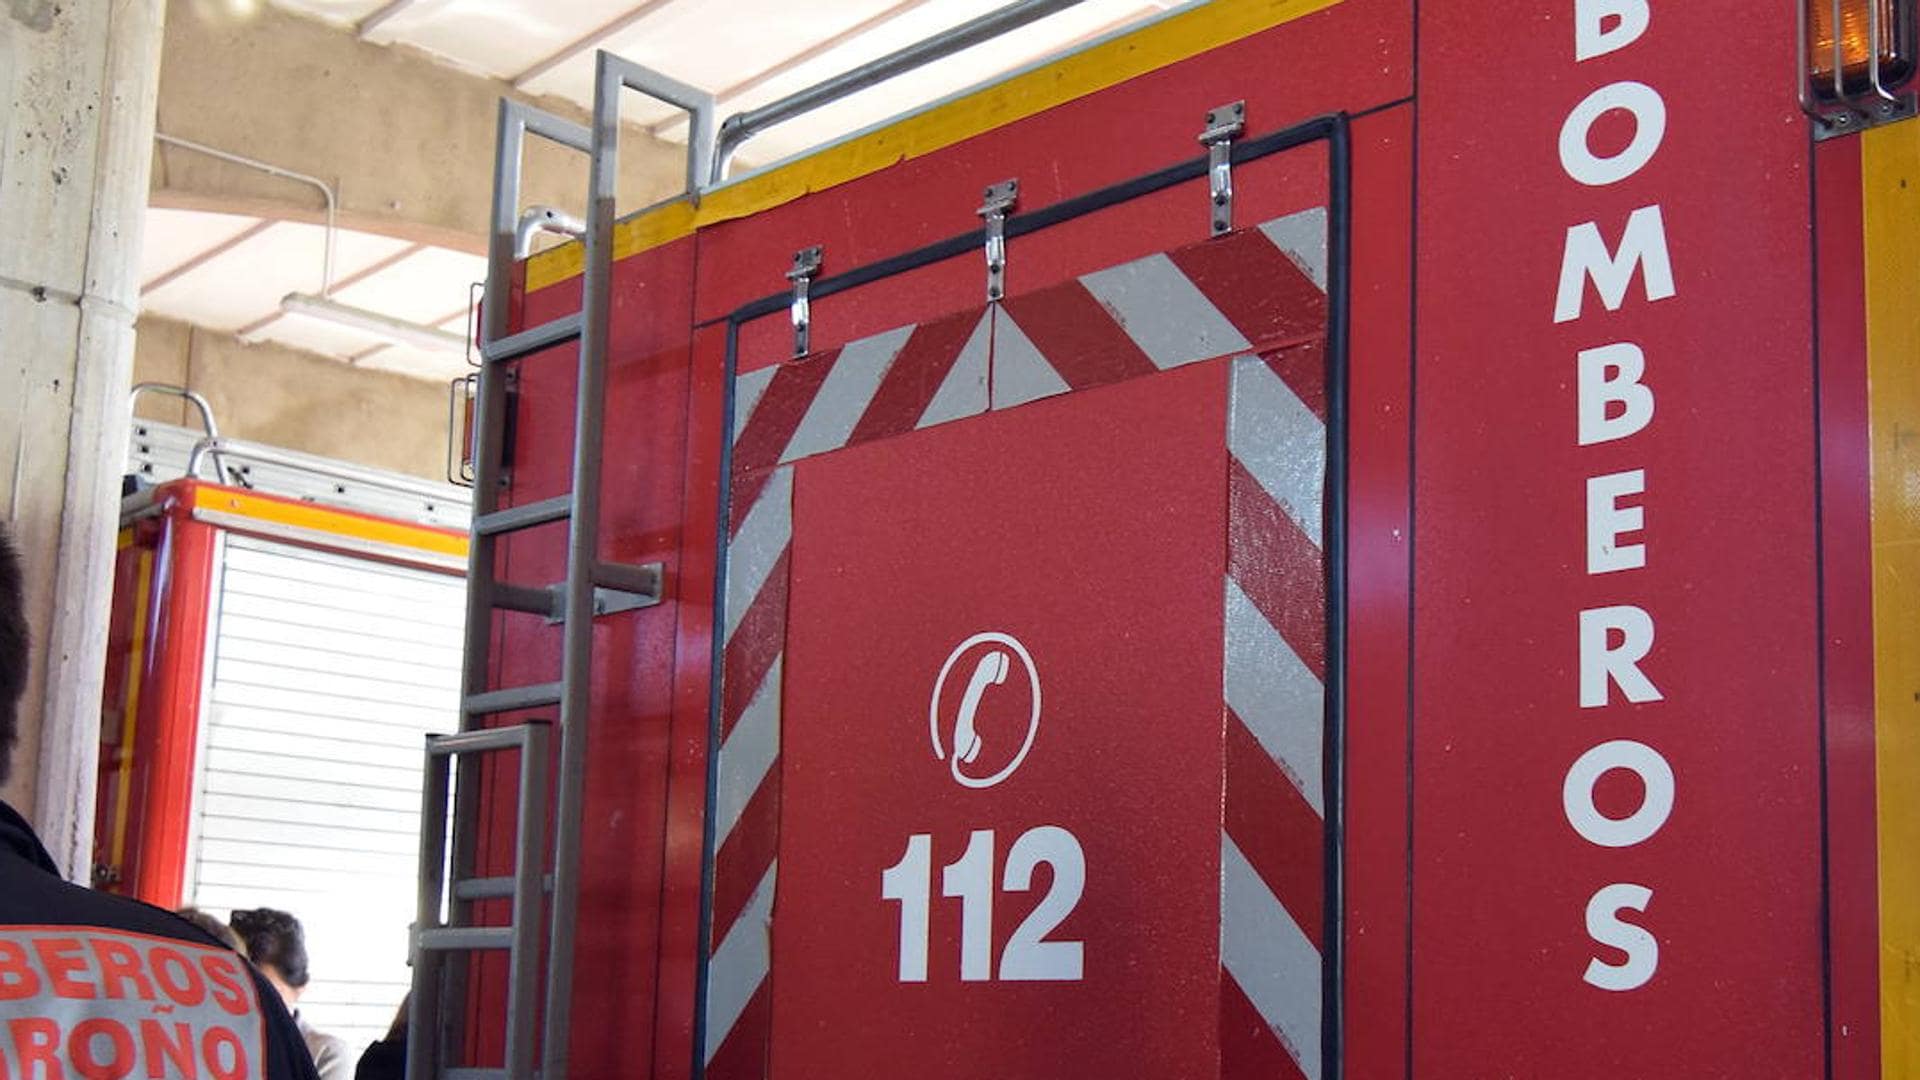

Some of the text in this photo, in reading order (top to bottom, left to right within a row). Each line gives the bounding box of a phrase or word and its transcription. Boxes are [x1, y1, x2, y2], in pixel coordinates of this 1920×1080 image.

[1553, 0, 1677, 991] BOMBEROS
[882, 824, 1086, 982] 112
[0, 1005, 249, 1080] ROÑO
